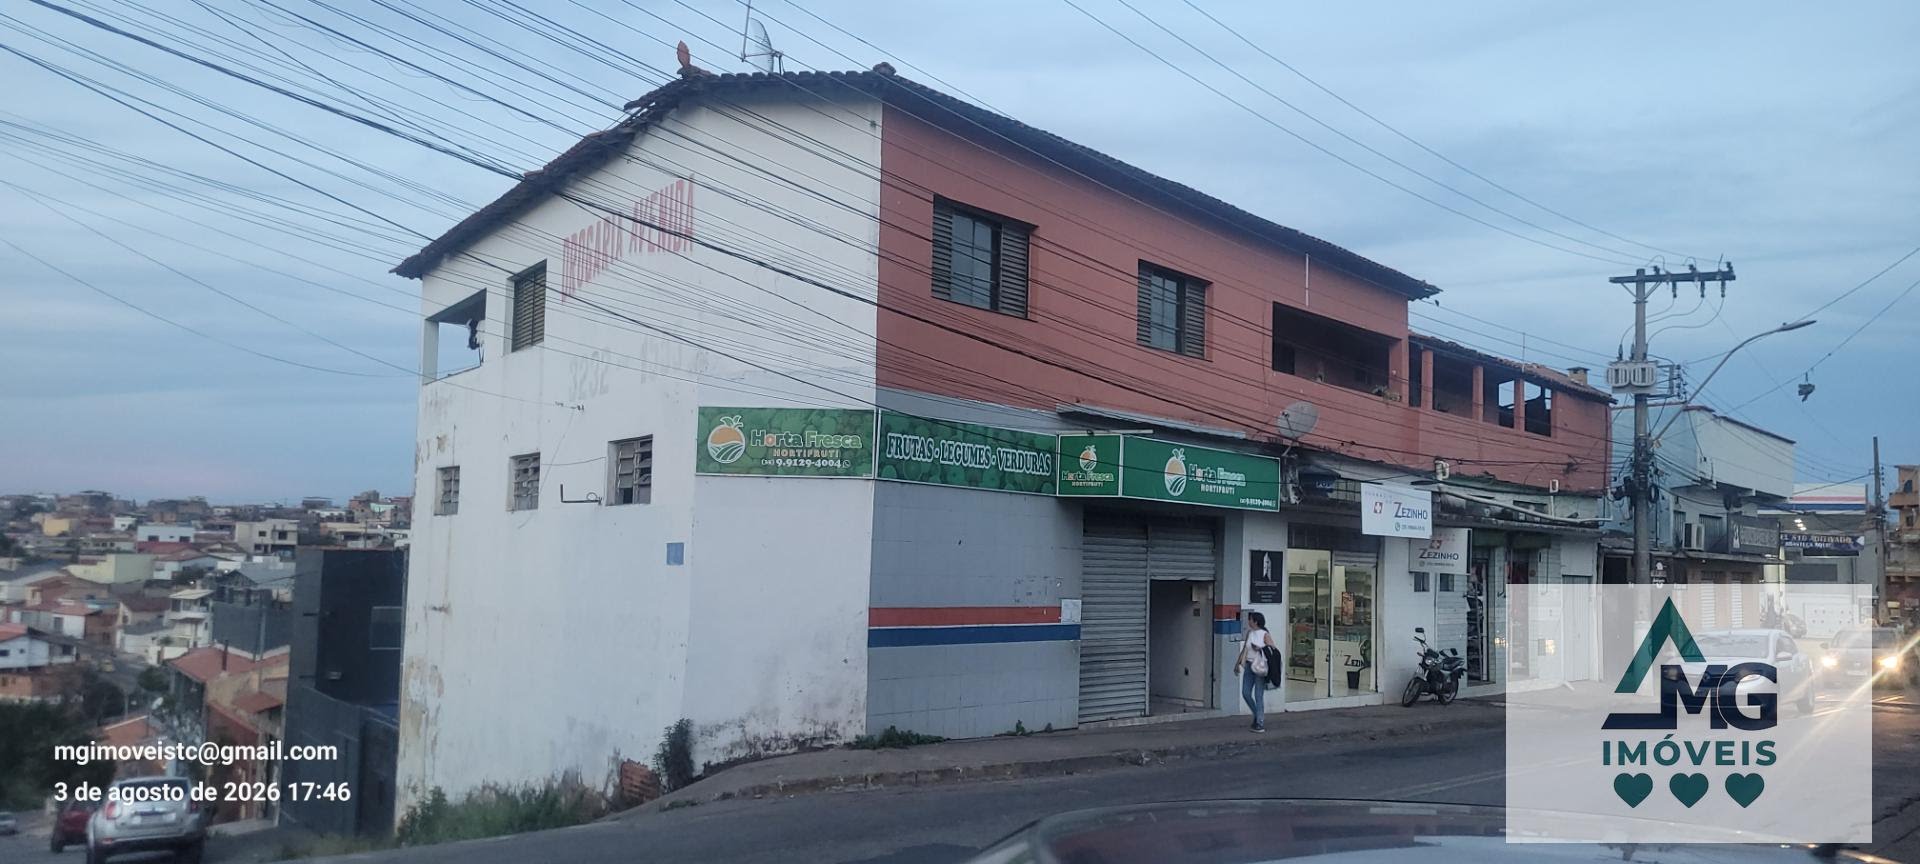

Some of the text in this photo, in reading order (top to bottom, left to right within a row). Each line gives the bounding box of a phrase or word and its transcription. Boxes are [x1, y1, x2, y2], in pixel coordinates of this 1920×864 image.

[561, 179, 694, 304] DROGARIA AVENIDA
[750, 429, 863, 449] Horta Fresca
[773, 449, 839, 458] HORTIFRUTI
[886, 432, 1051, 476] FRUTAS LEGUMES VERDURAS
[776, 458, 842, 468] 9.9129-4004
[1061, 470, 1087, 481] Horta
[1188, 463, 1217, 484] Horta
[1200, 484, 1235, 495] HORTIFRUTI
[1394, 501, 1428, 520] ZEZINHO
[1419, 548, 1459, 561] ZEZINHO
